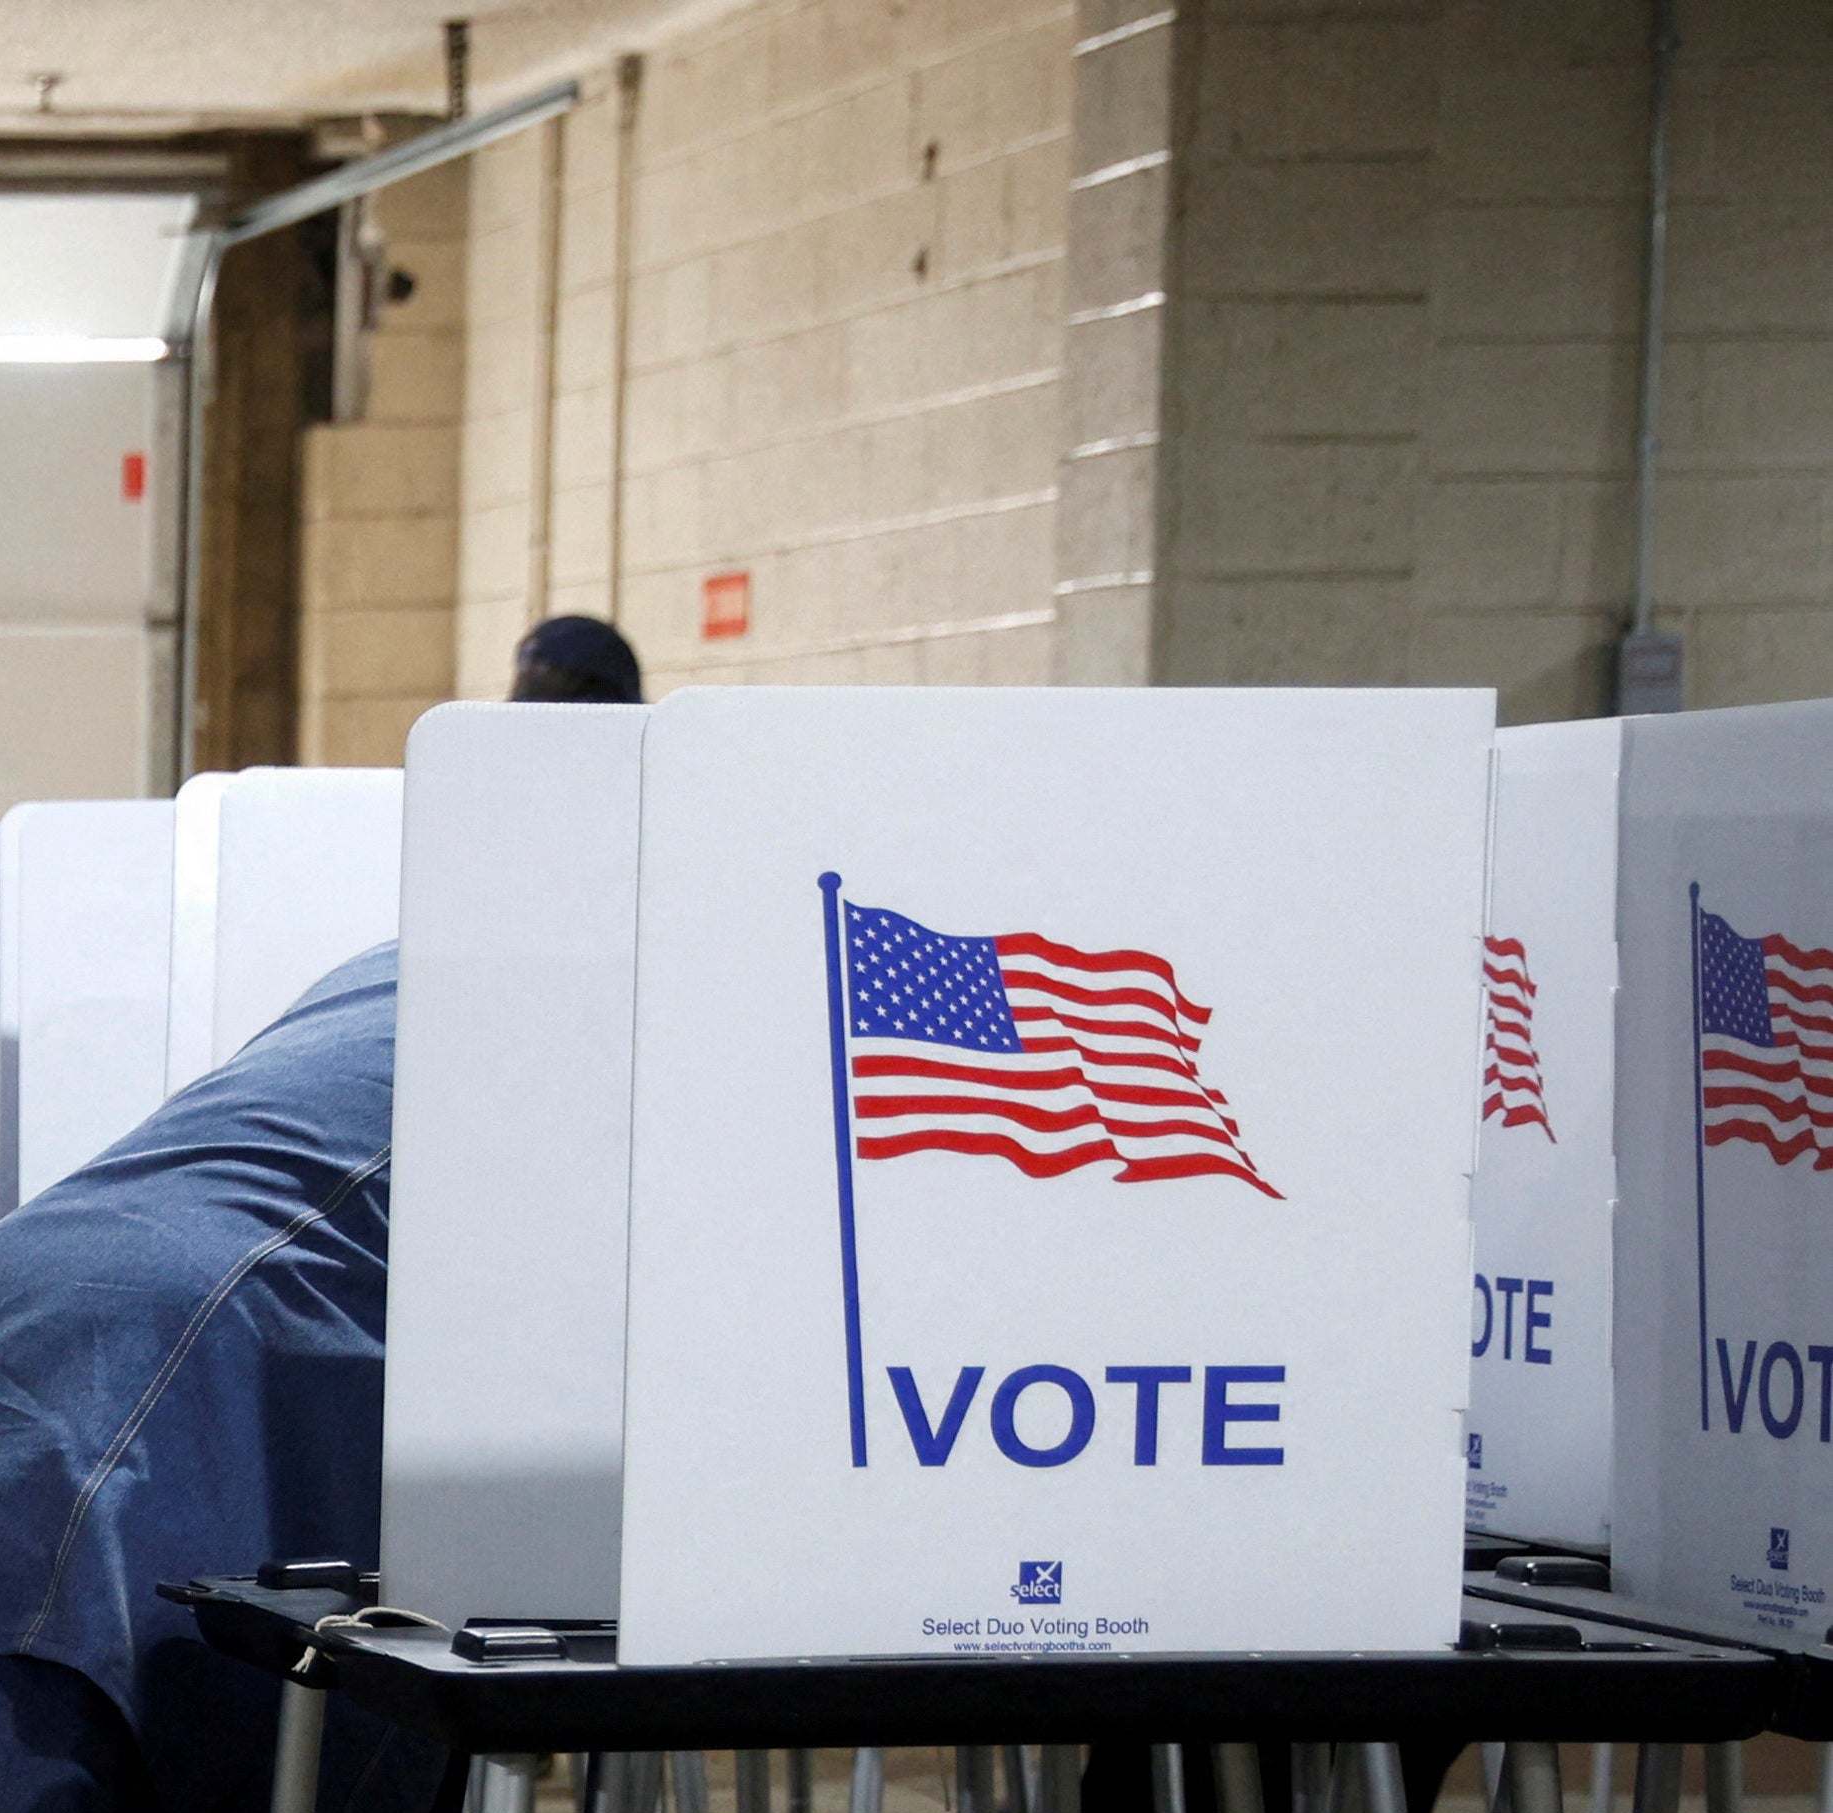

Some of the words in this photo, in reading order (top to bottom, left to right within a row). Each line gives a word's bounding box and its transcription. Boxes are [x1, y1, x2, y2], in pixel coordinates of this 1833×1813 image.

[886, 1363, 1286, 1467] VOTE
[1010, 1581, 1061, 1598] select
[922, 1617, 980, 1635] Select
[987, 1618, 1024, 1635] Duo
[1030, 1617, 1088, 1638] Voting
[1096, 1617, 1149, 1635] Booth
[954, 1641, 1111, 1652] www.selectvotingbooths.com
